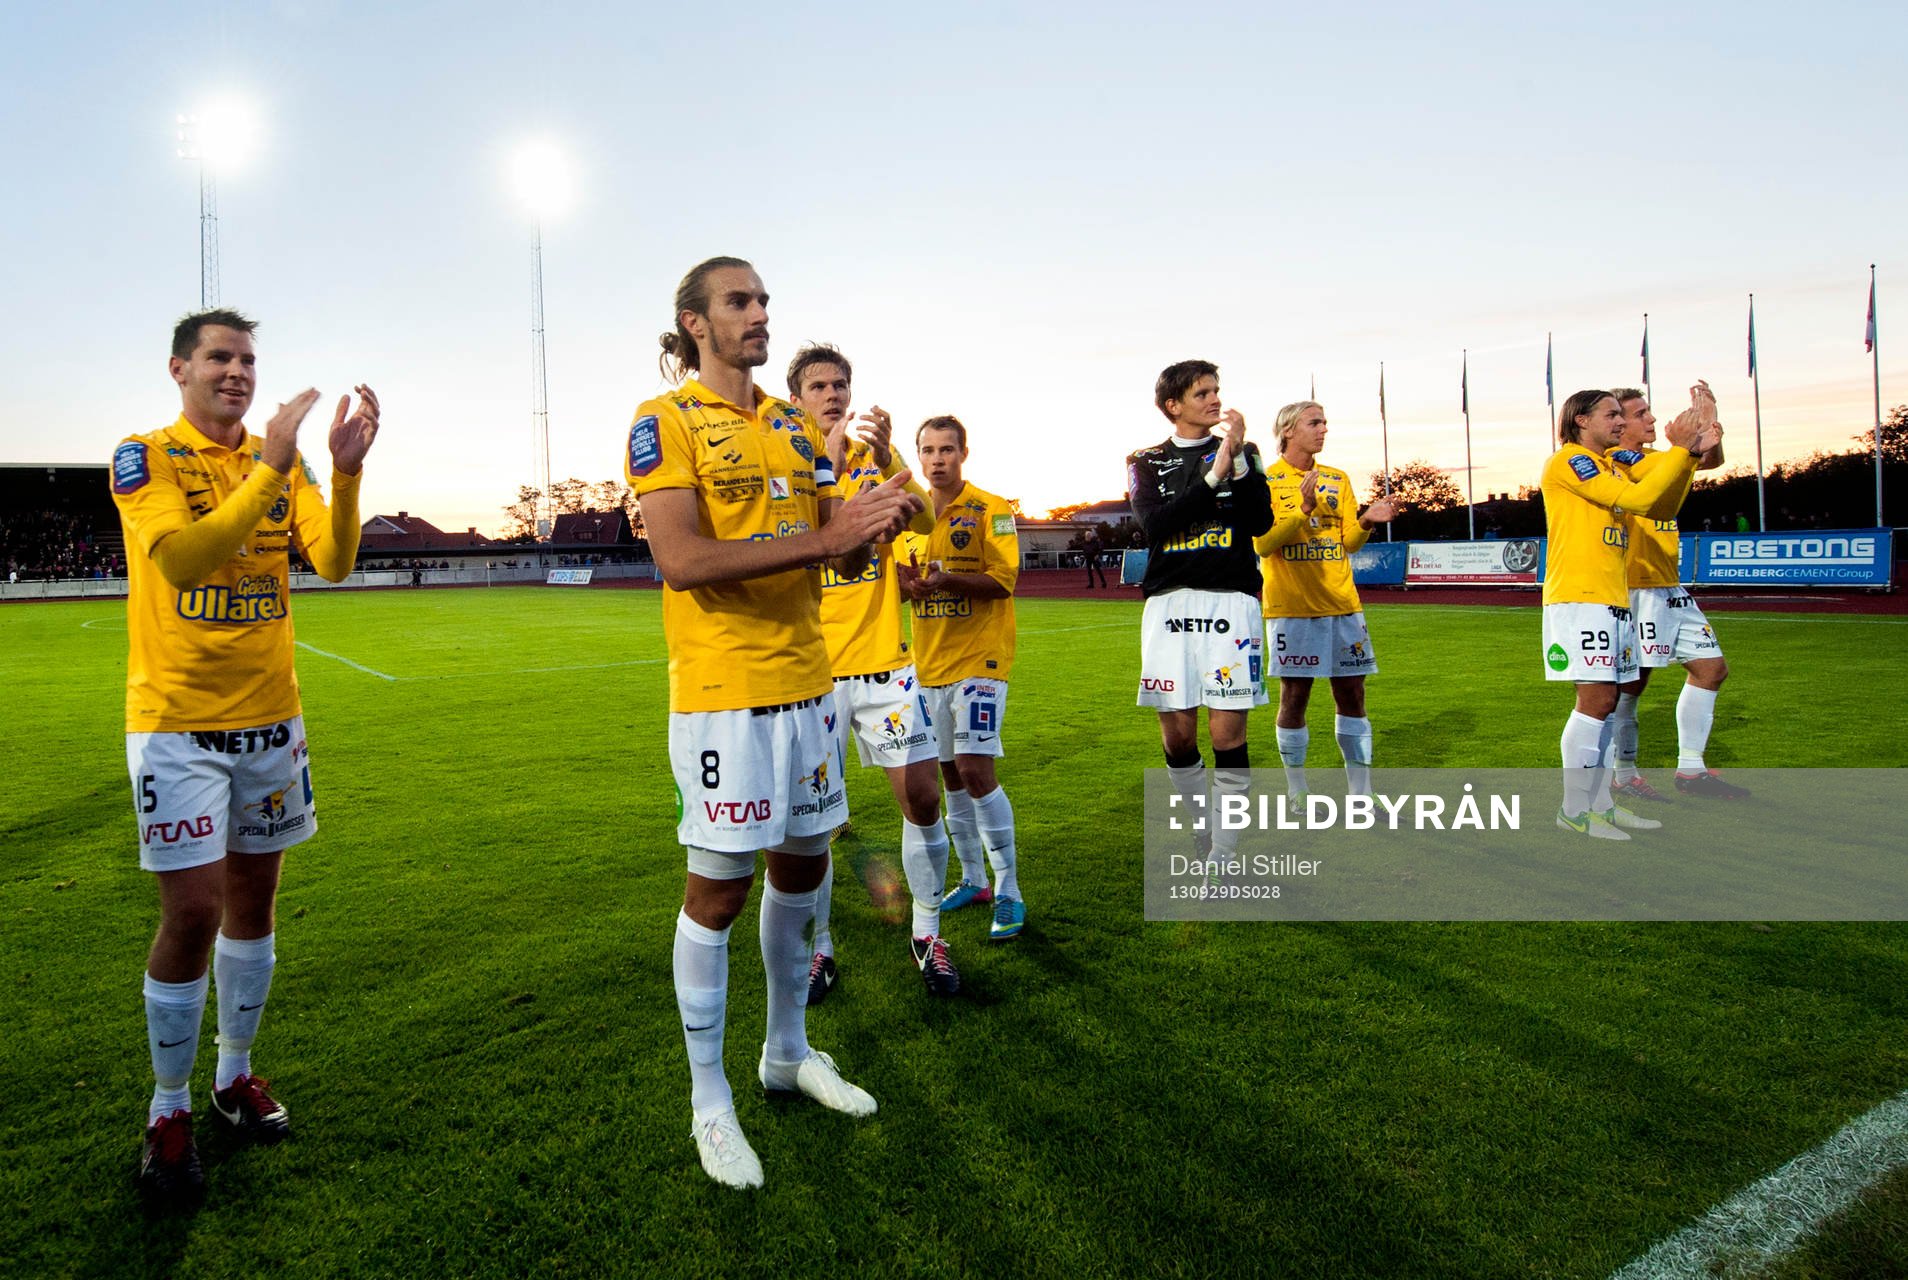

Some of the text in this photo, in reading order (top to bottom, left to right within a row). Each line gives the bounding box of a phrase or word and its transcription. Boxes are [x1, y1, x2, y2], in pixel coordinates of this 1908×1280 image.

[1281, 543, 1344, 561] Ullared
[1710, 537, 1875, 558] ABETONG
[1708, 567, 1874, 580] HEIDELBERGCEMENT Group
[178, 585, 288, 622] Ullared
[1165, 618, 1230, 634] NETTO
[1640, 622, 1657, 640] 13
[1276, 633, 1287, 651] 5
[1581, 631, 1610, 650] 29
[190, 723, 290, 754] NETTO
[700, 750, 720, 789] 8
[792, 804, 819, 817] SPECIAL
[238, 825, 267, 837] SPECIAL
